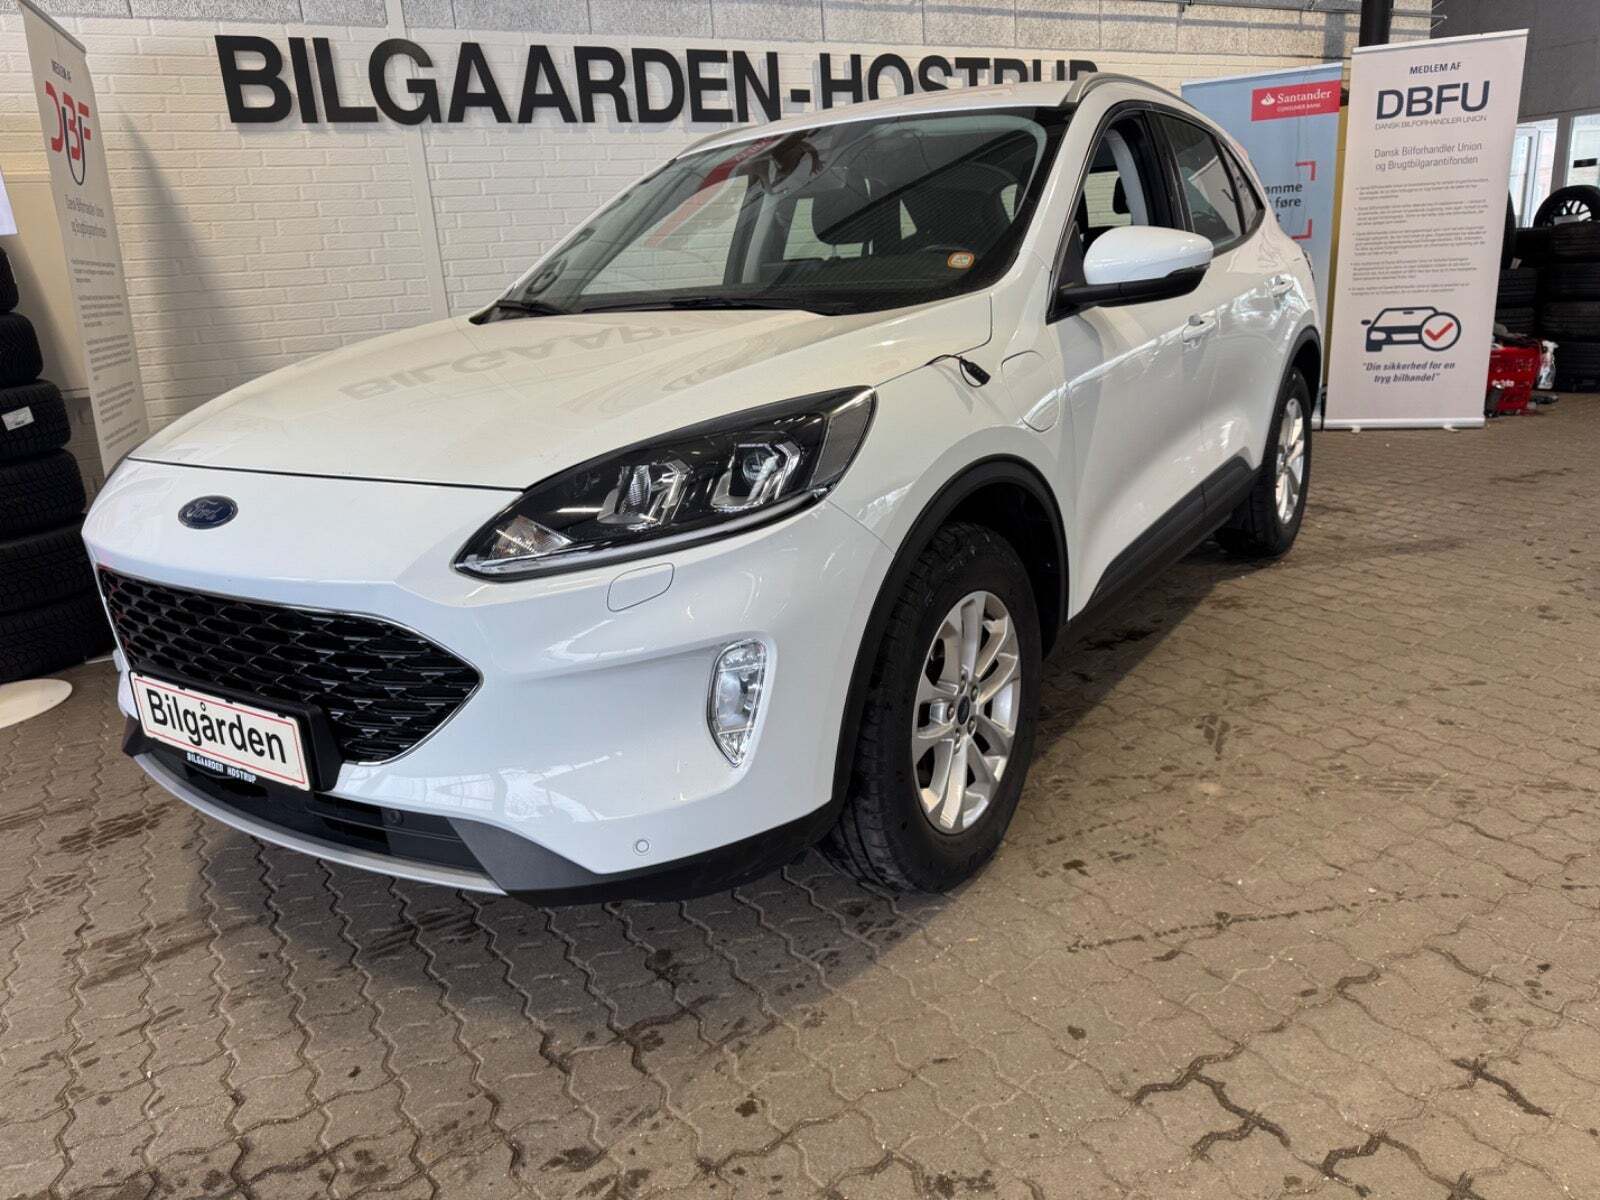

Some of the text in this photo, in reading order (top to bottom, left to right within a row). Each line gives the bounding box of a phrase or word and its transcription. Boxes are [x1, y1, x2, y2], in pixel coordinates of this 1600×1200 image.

[1409, 61, 1462, 75] MEDLEM AF
[1277, 88, 1332, 104] Santander
[1376, 80, 1490, 120] DBFU
[1375, 122, 1400, 131] DANSK
[1463, 115, 1487, 124] UNION
[1374, 142, 1482, 159] Dansk Bilforhandler Union
[1375, 155, 1479, 172] og Brugtbilgarantifonden
[1275, 196, 1302, 208] føre
[1383, 361, 1426, 371] sikkerhed
[1428, 361, 1442, 370] for
[1443, 362, 1455, 370] en
[1374, 374, 1391, 384] tryg
[146, 688, 287, 764] Bilgården
[186, 752, 257, 784] BILGAARDEN HOSTRUP
